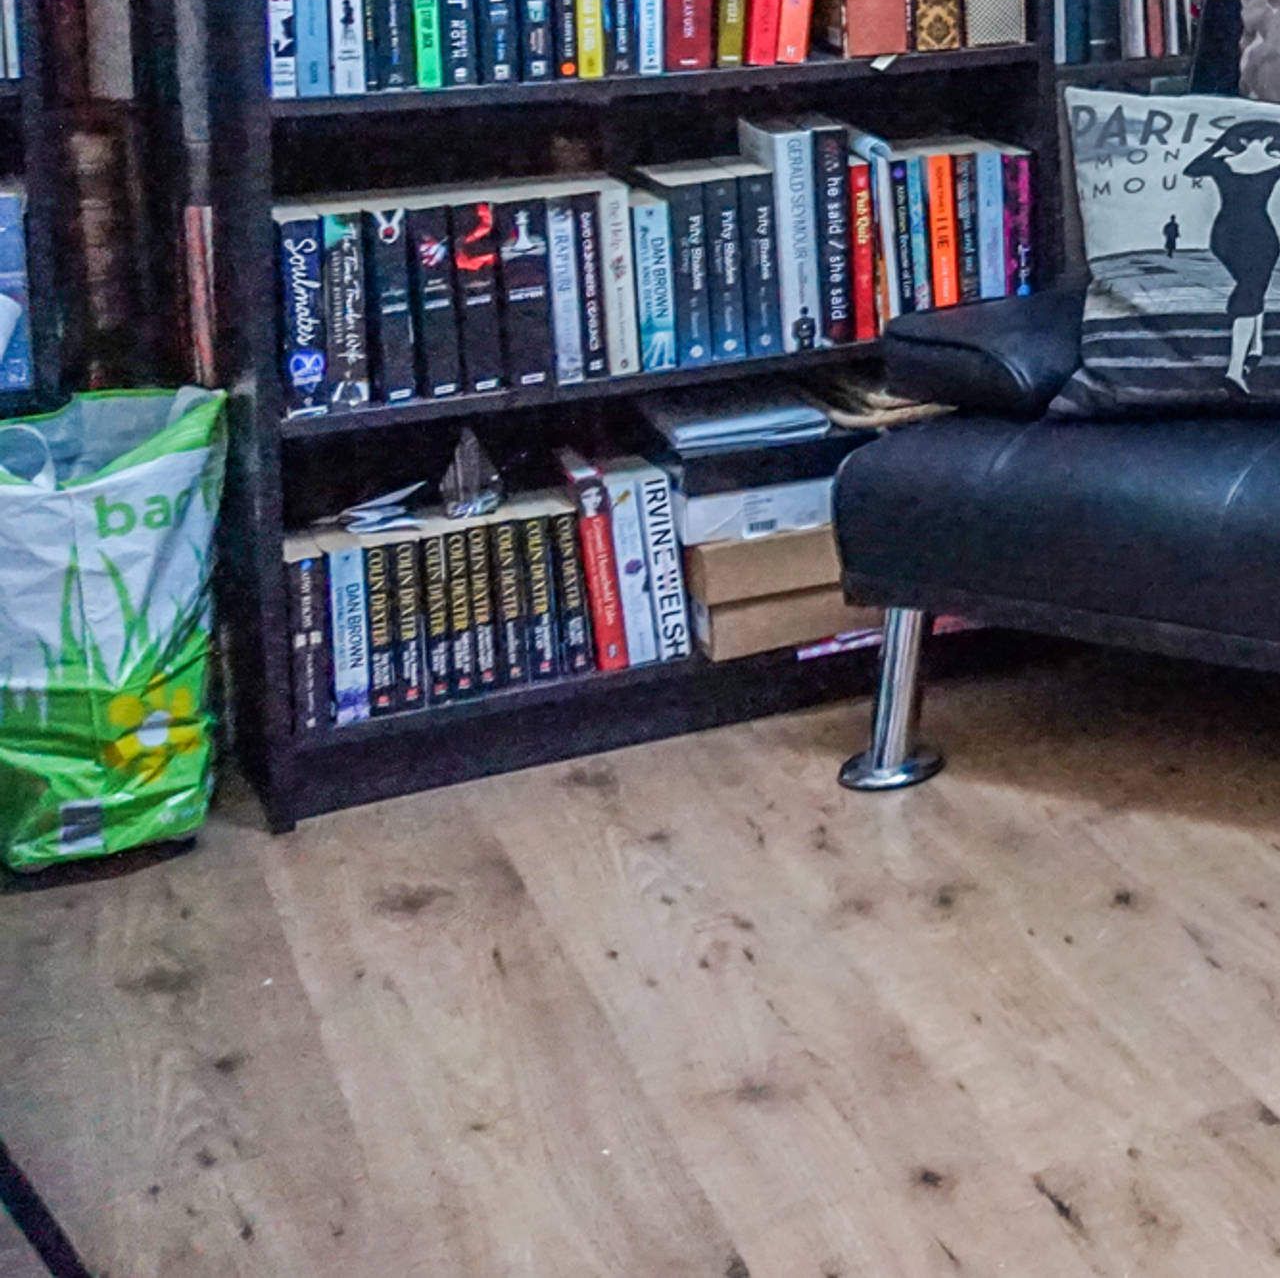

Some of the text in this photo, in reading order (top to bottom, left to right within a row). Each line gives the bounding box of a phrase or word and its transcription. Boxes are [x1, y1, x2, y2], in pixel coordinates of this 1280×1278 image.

[450, 20, 460, 59] ROTH
[1071, 104, 1238, 147] PARIS
[1079, 175, 1205, 201] MOUR
[1094, 148, 1181, 171] MON
[610, 200, 625, 250] The Help
[787, 139, 808, 260] GERALD SEYMOUR
[855, 190, 869, 245] Pub Quiz
[341, 223, 358, 283] The Time
[688, 215, 704, 290] Fifty Shades
[721, 211, 736, 285] Fifty Shades
[757, 206, 771, 280] Fifty Shades
[828, 176, 847, 321] he said / she said
[937, 225, 949, 250] LIE
[284, 239, 320, 345] Soulmates
[650, 237, 669, 318] DAN BROWN
[368, 549, 383, 590] COLIN
[397, 545, 413, 585] COLIN
[426, 539, 443, 580] COLIN
[449, 534, 468, 630] COLIN DEXTER
[468, 530, 488, 624] COLIN DEXTER
[498, 526, 518, 620] COLIN DEXTER
[526, 521, 548, 615] COLIN DEXTER
[557, 517, 581, 608] COLIN DEXTER
[644, 479, 686, 660] IRVINE WELSH
[346, 583, 364, 668] DAN BROWN
[371, 594, 389, 646] DEXTER
[399, 588, 417, 640] DEXTER
[428, 584, 445, 635] DEXTER
